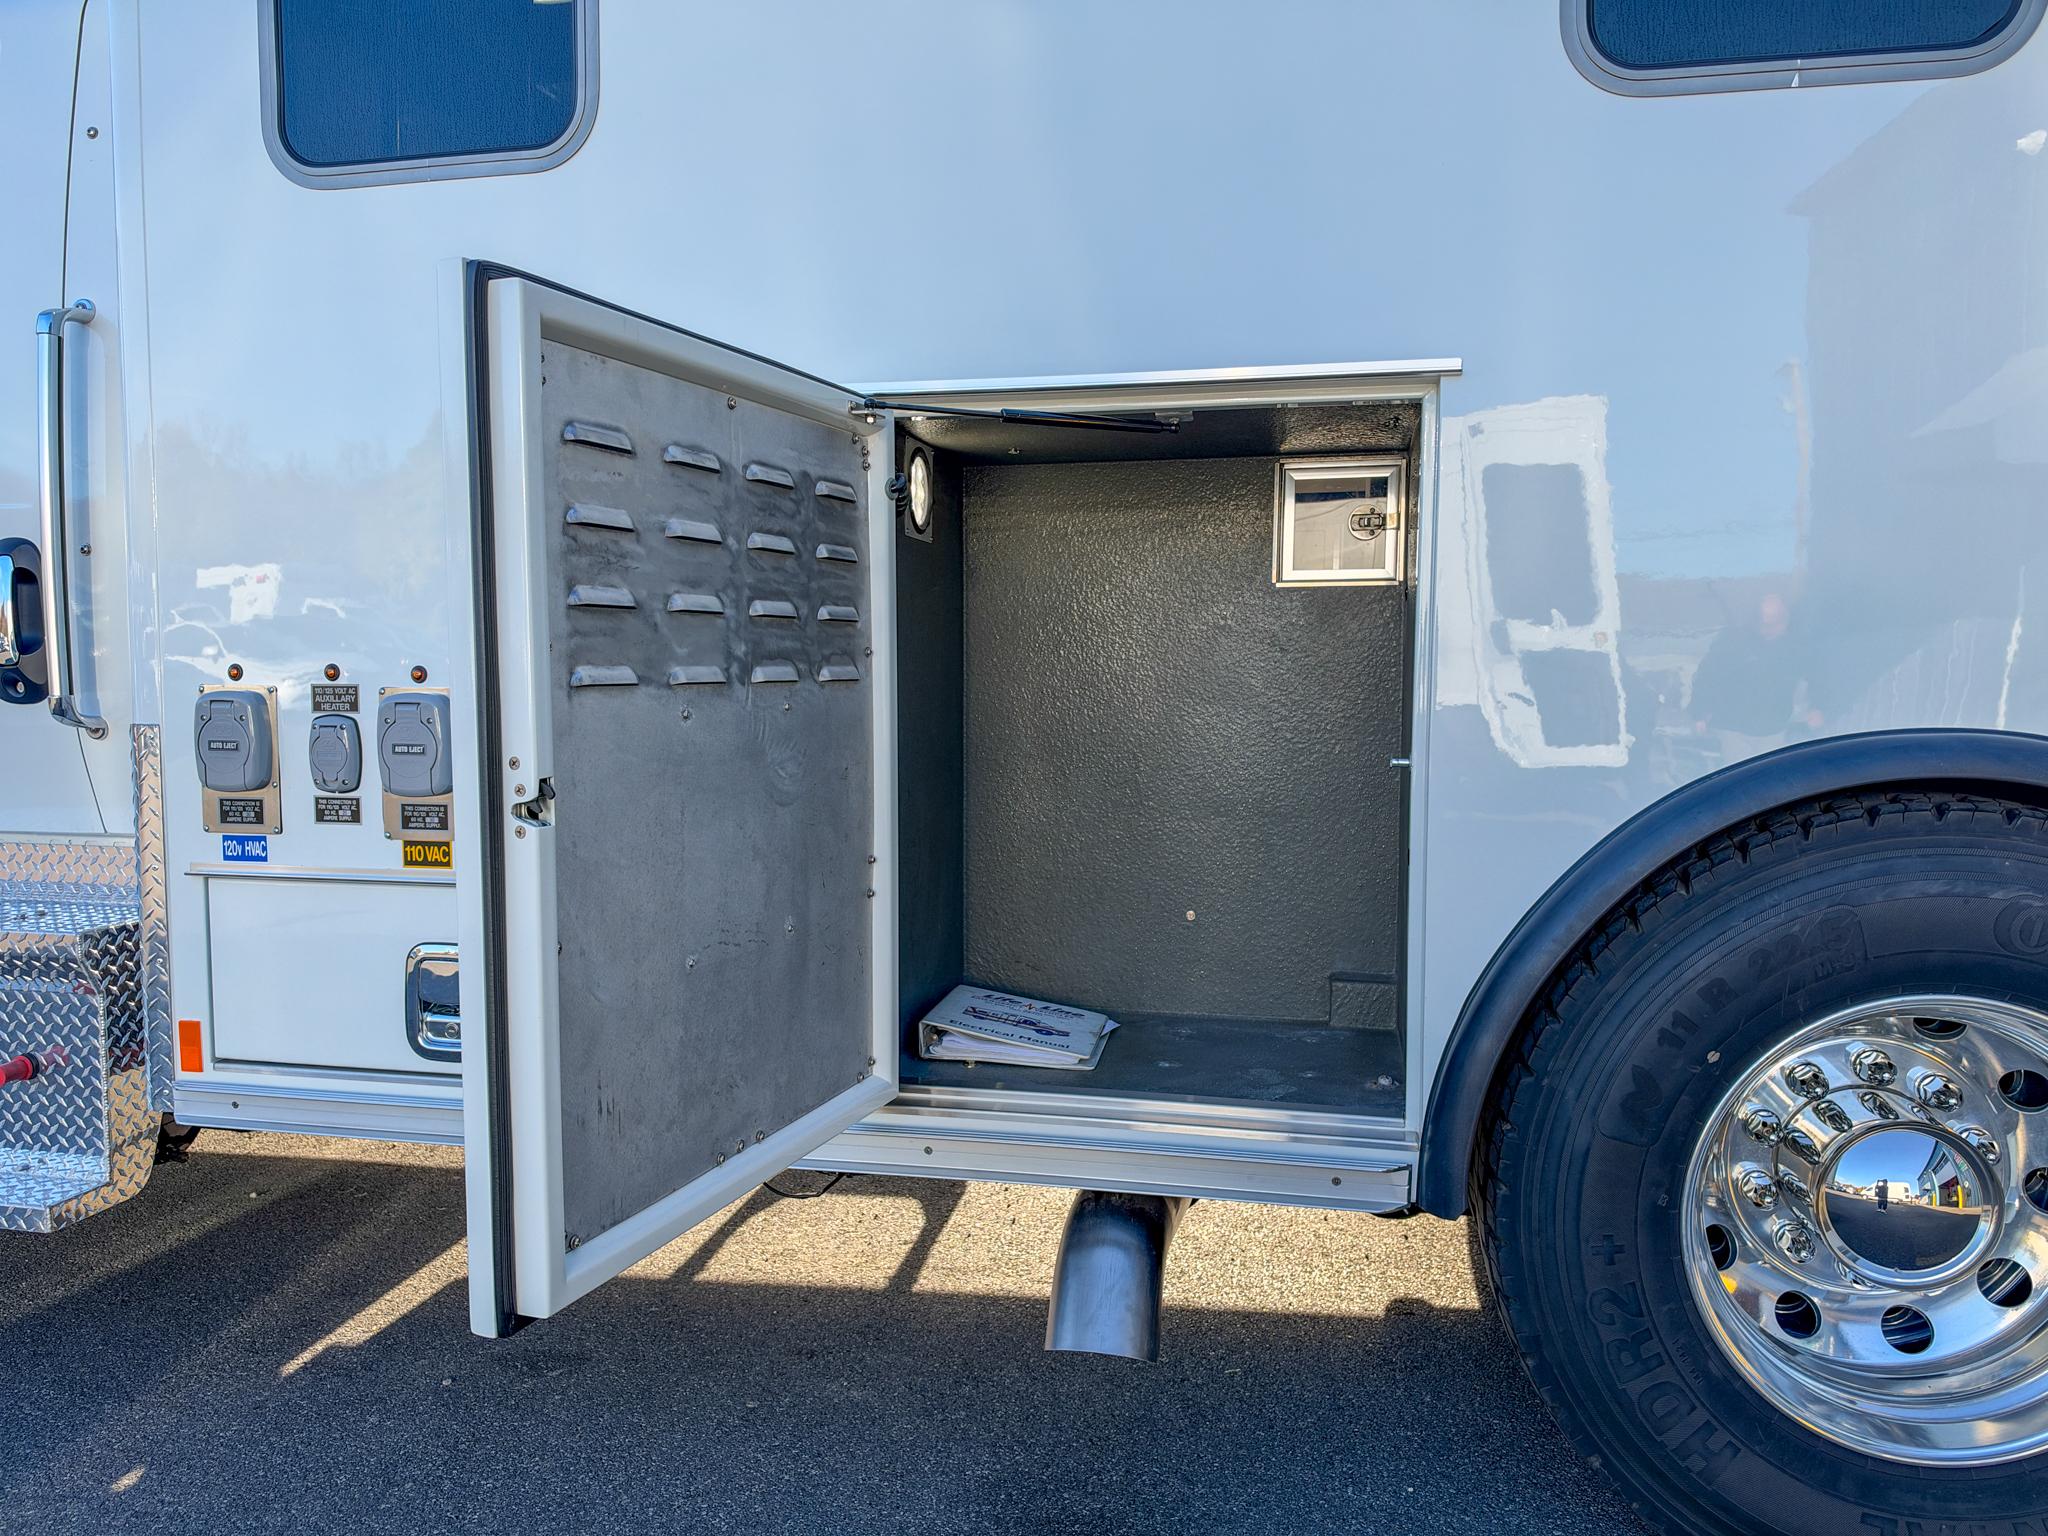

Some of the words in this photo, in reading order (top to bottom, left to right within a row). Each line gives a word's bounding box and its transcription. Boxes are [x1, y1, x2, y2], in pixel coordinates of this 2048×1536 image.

[334, 687, 348, 695] VOLT
[314, 694, 356, 703] AUXILLARY
[321, 703, 350, 711] HEATER
[394, 745, 408, 753] AUTO
[408, 745, 424, 753] EJECT
[223, 840, 242, 856] 120v
[244, 840, 267, 857] HVAC
[404, 845, 425, 862] 110
[425, 845, 449, 863] VAC
[949, 1019, 1014, 1038] Electrical
[1018, 1034, 1070, 1049] Manual
